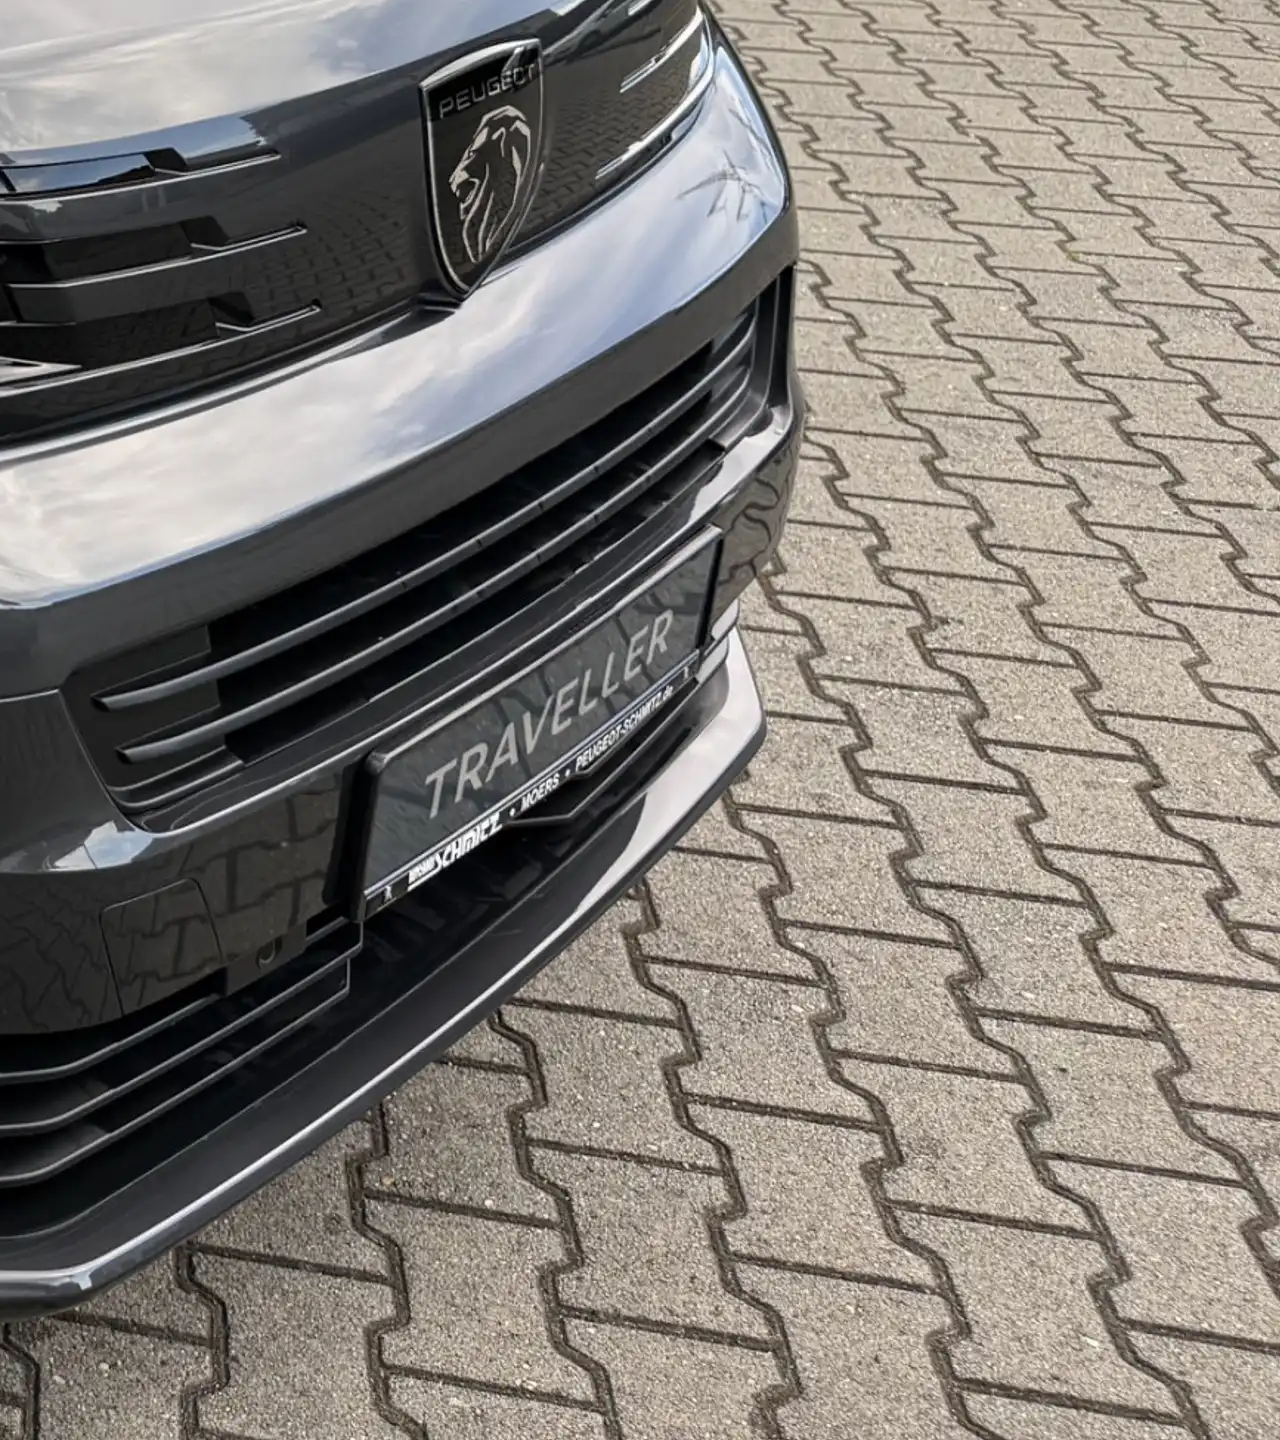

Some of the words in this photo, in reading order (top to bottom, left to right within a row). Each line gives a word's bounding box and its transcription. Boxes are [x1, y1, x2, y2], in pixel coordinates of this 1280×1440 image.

[439, 63, 536, 120] PEUGEOT
[424, 608, 674, 820] TRAVELLER
[520, 772, 561, 812] MOERS
[574, 684, 674, 773] PEUGEOT-SCHMITZ.de
